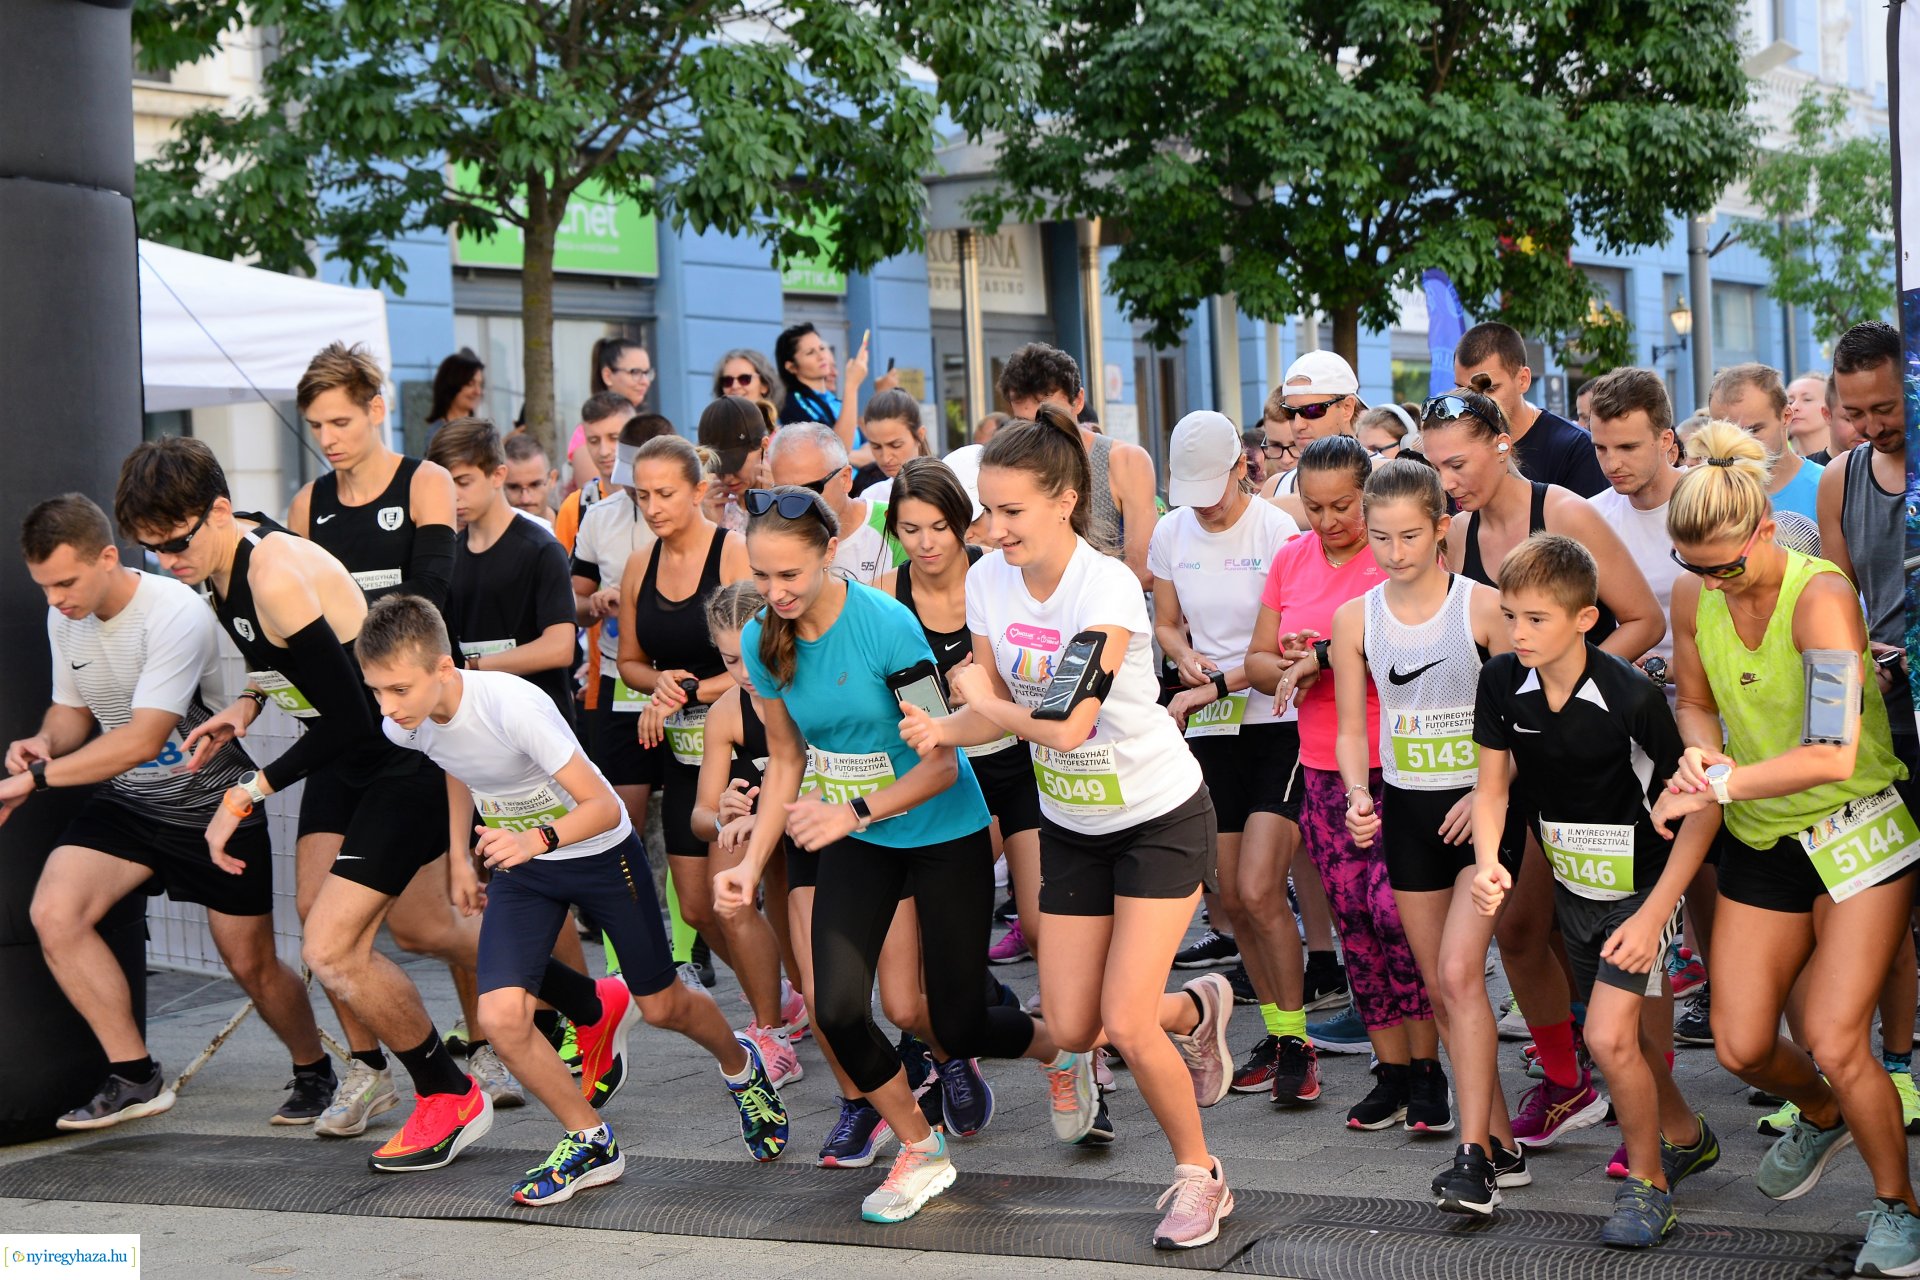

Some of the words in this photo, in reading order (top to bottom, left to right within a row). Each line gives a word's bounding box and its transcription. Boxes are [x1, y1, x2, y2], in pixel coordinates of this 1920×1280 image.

[928, 231, 1020, 268] KOONA
[672, 731, 704, 752] 506
[1407, 740, 1475, 768] 5143
[1043, 771, 1107, 801] 5049
[1830, 817, 1905, 874] 5144
[1552, 850, 1617, 886] 5146
